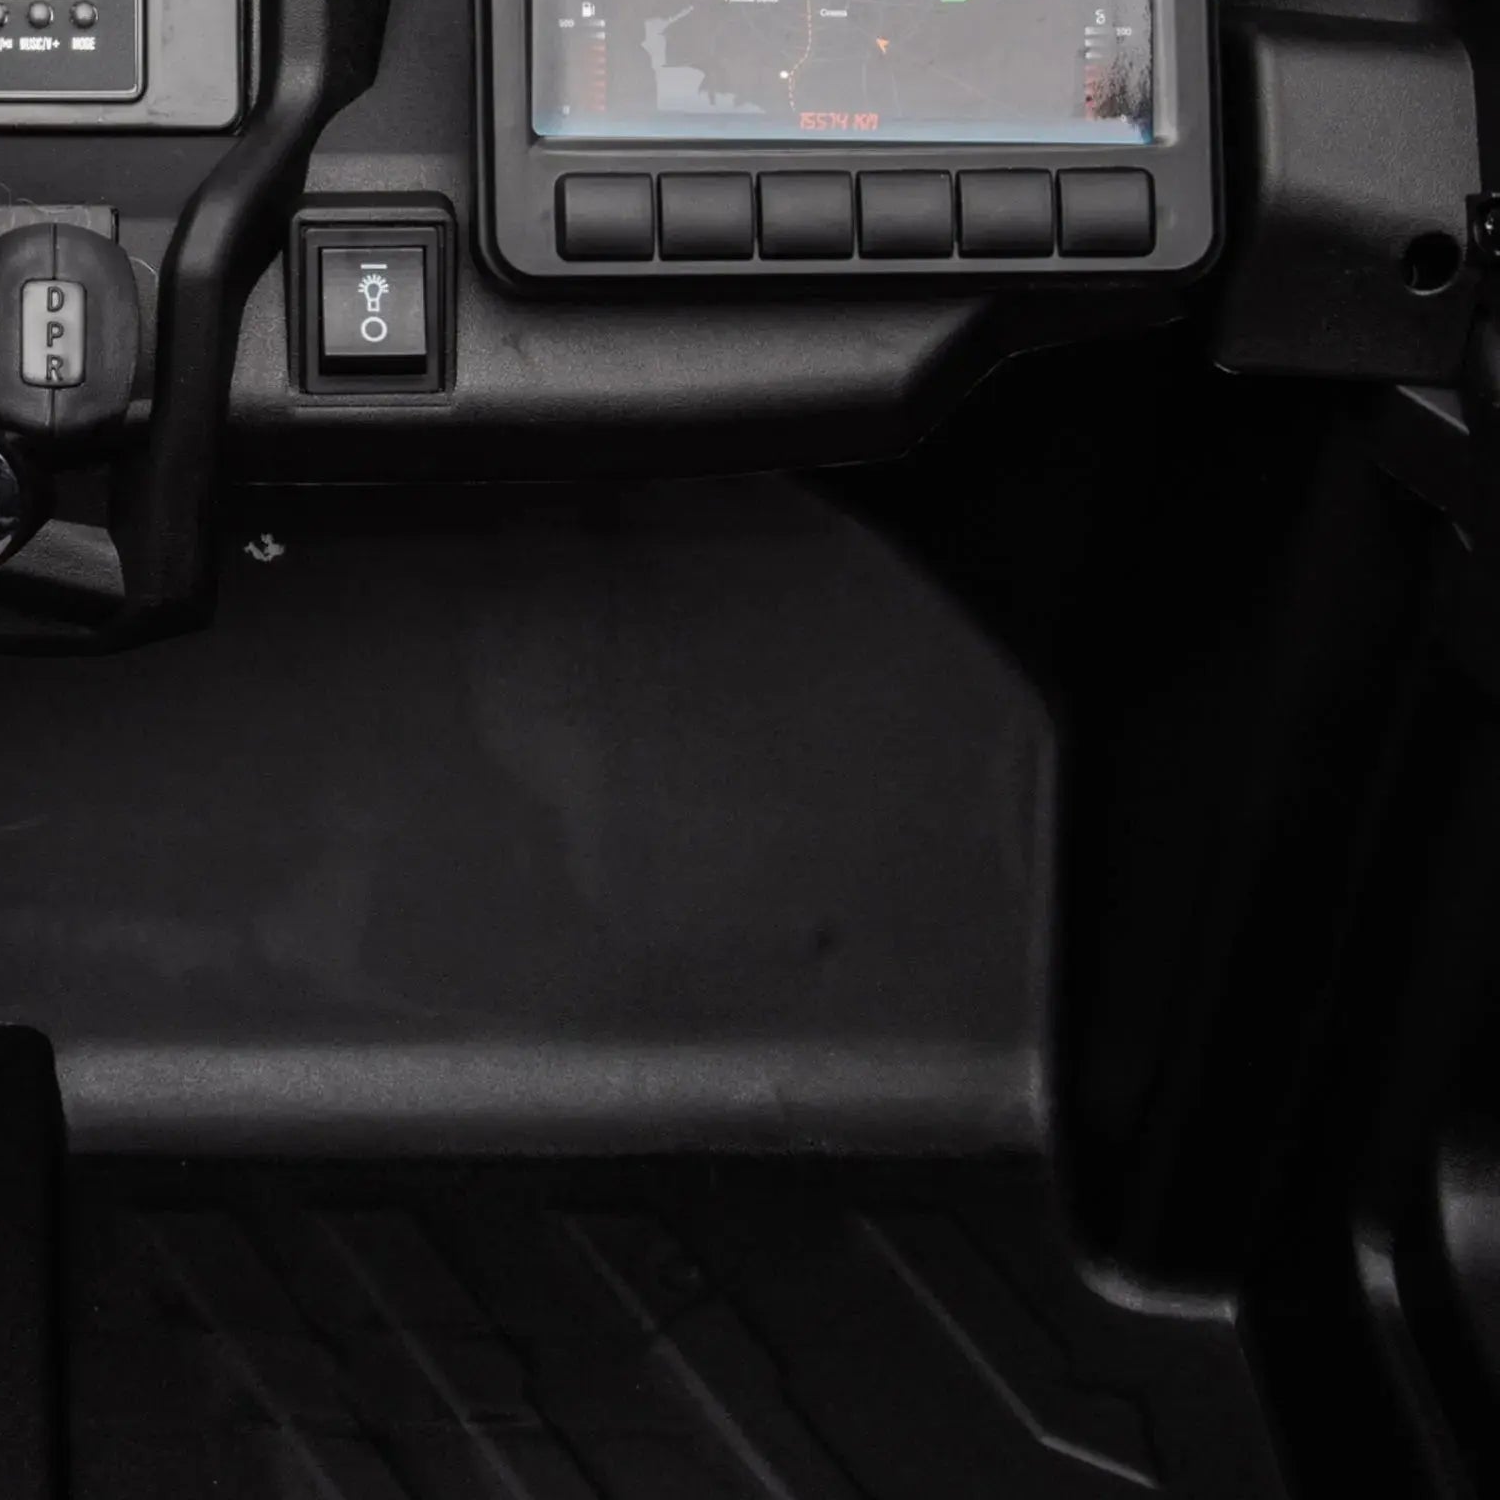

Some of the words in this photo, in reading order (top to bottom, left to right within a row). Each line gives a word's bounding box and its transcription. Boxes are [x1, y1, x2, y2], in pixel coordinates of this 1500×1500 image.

[47, 285, 65, 313] D
[47, 321, 65, 348] P
[46, 354, 64, 381] R
